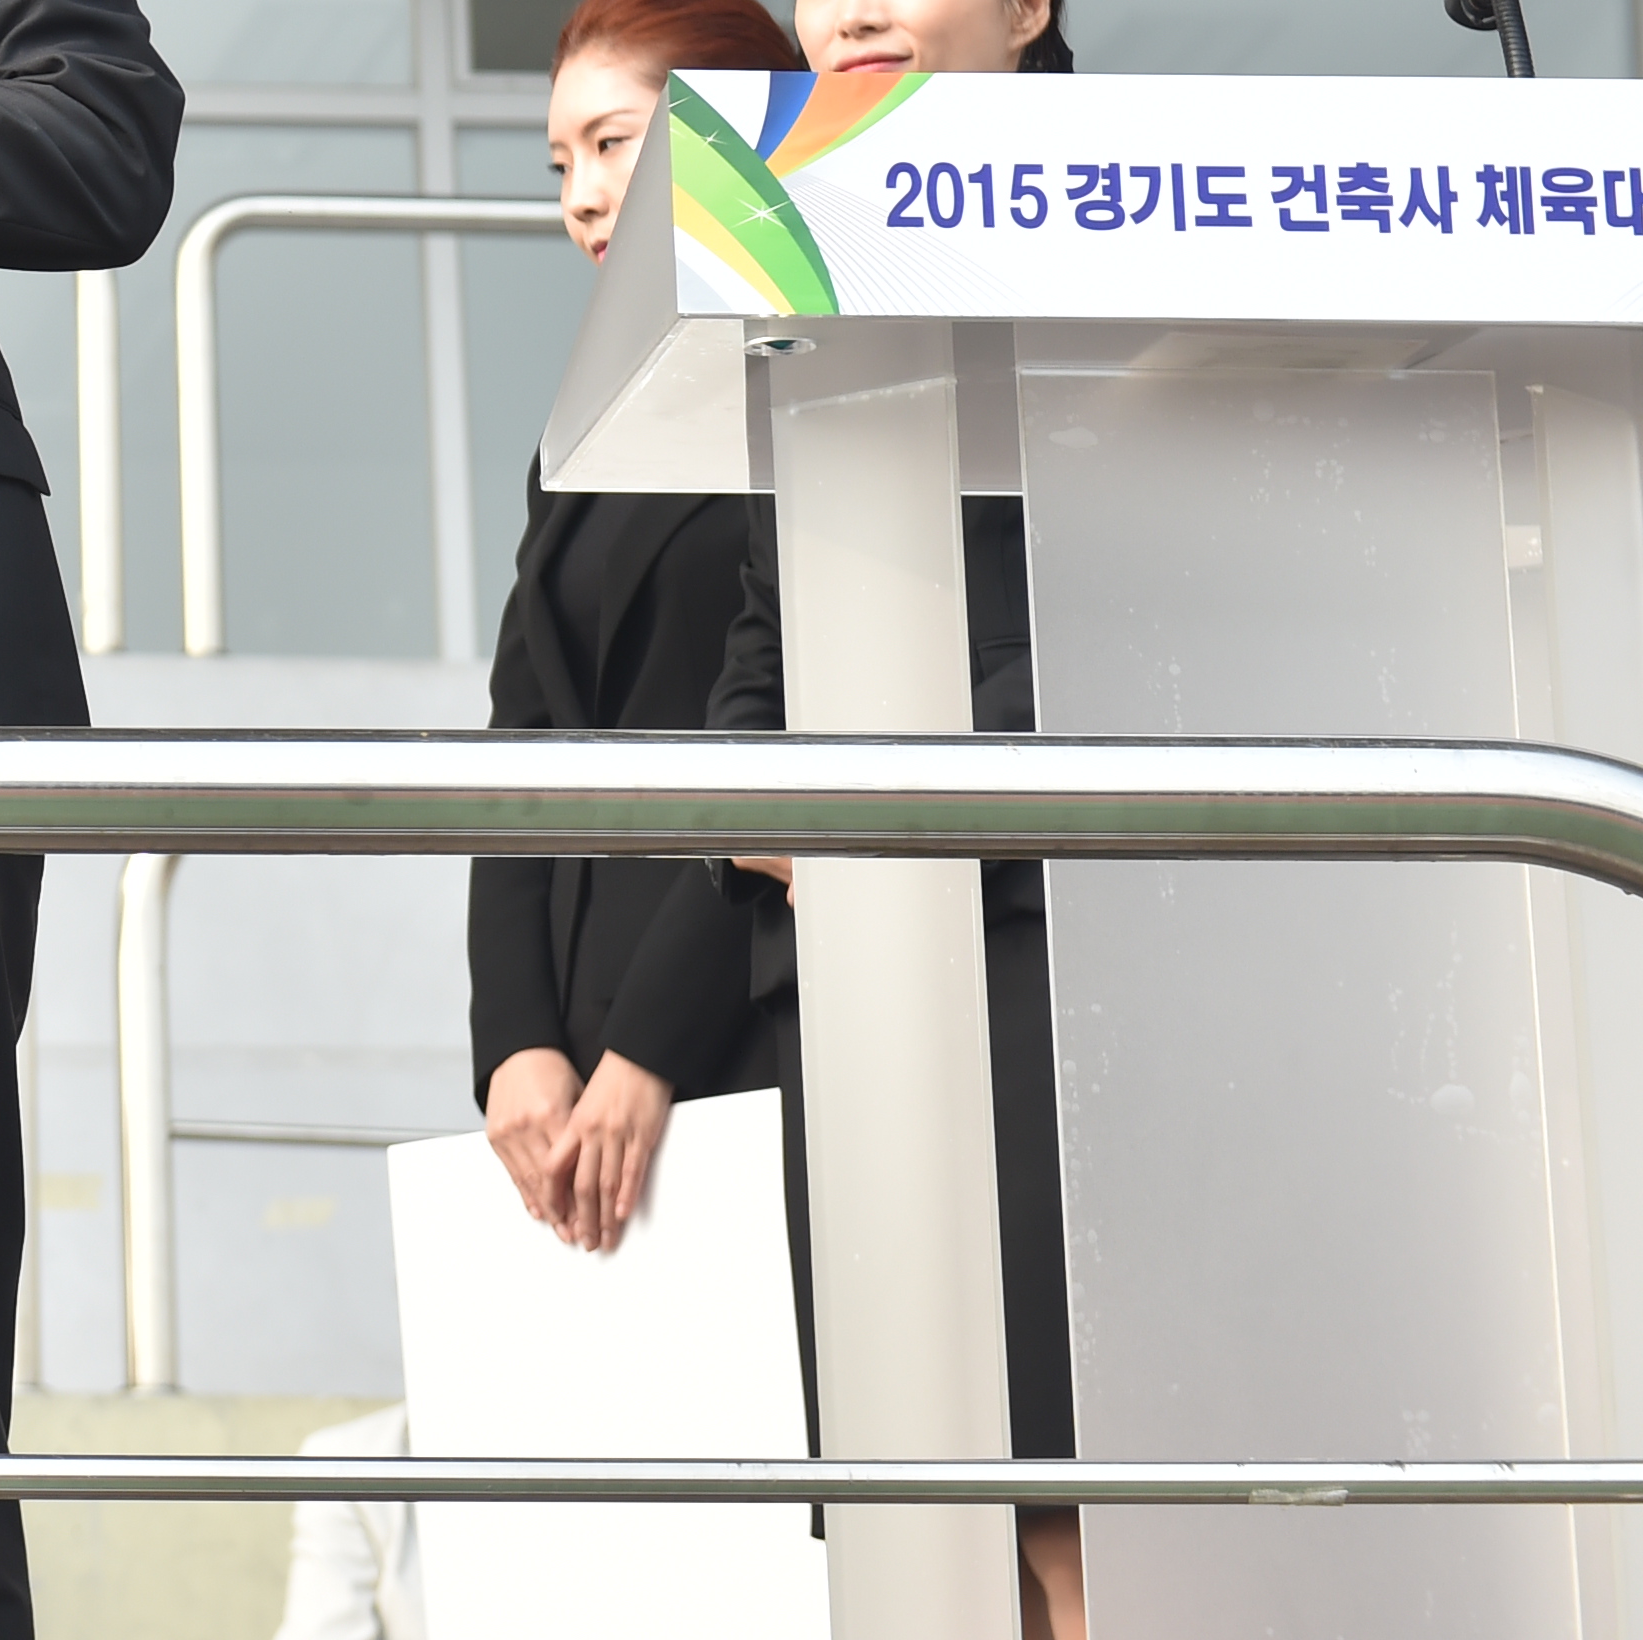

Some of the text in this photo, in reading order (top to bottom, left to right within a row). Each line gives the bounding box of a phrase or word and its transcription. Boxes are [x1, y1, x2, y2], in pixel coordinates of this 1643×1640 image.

[886, 162, 1048, 229] 2015
[1066, 163, 1252, 231] 경기도
[1271, 163, 1458, 234] 건축사
